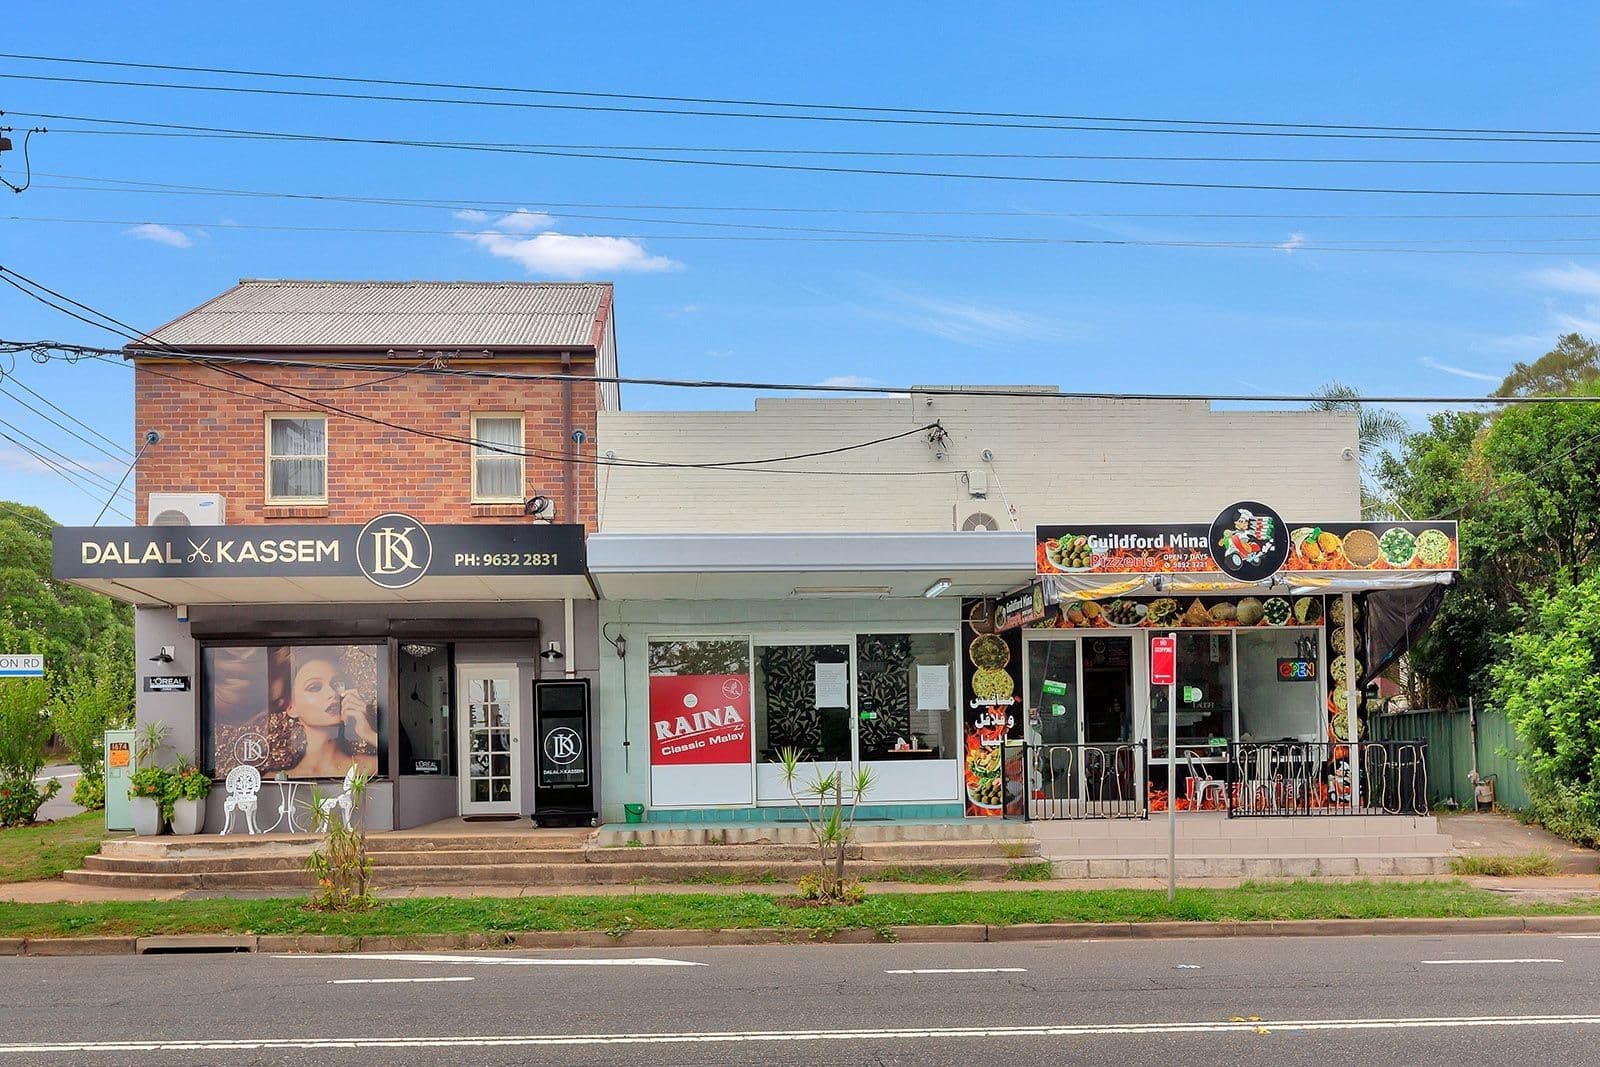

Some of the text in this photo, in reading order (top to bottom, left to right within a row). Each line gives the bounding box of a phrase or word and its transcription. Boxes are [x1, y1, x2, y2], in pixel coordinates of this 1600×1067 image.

[1087, 532, 1208, 549] Guildford Mina
[81, 539, 339, 564] DALAL KASSEM
[454, 553, 558, 567] PH: 9632 2831
[1089, 553, 1156, 568] Pizzeria
[23, 658, 40, 668] RD
[1280, 662, 1315, 677] OPEN
[654, 705, 744, 741] RAINA
[661, 732, 745, 756] Classic Malay
